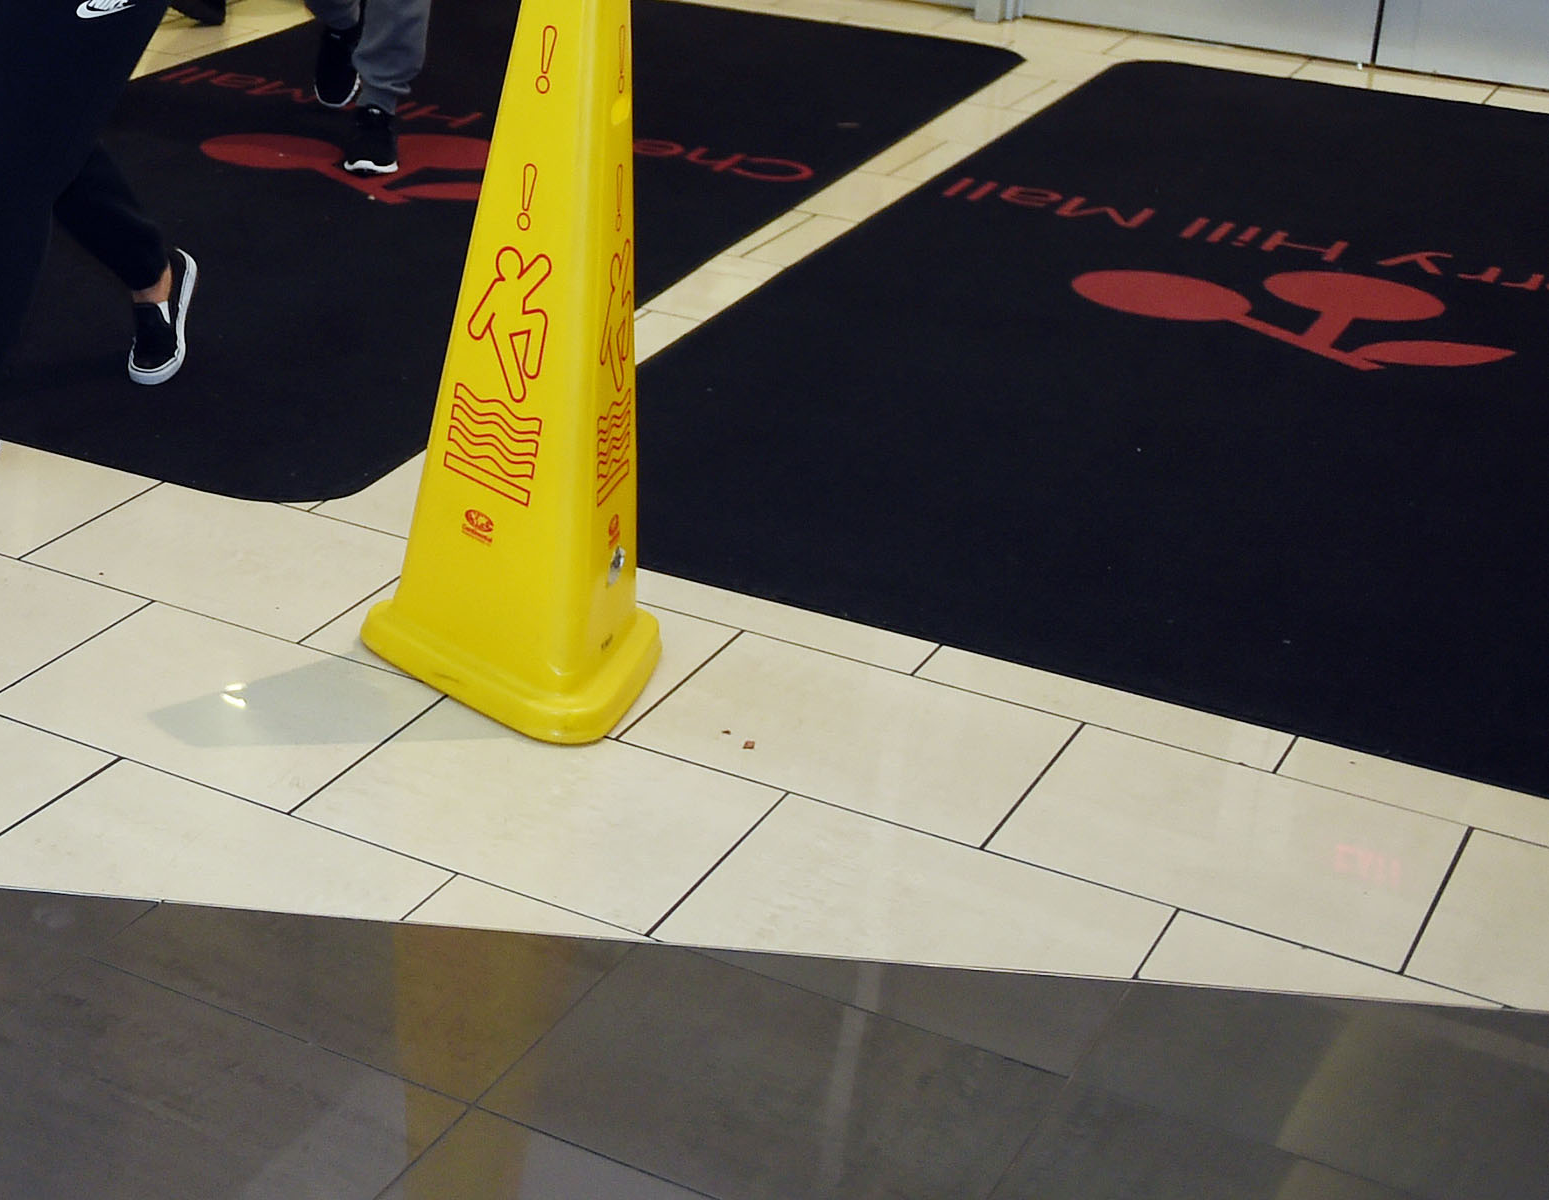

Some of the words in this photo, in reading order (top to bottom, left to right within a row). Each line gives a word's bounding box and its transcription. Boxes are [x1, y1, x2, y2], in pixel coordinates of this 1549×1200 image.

[633, 138, 815, 183] Che
[942, 177, 1156, 228] Mall
[1180, 217, 1349, 261] Hill
[1377, 251, 1549, 291] rry
